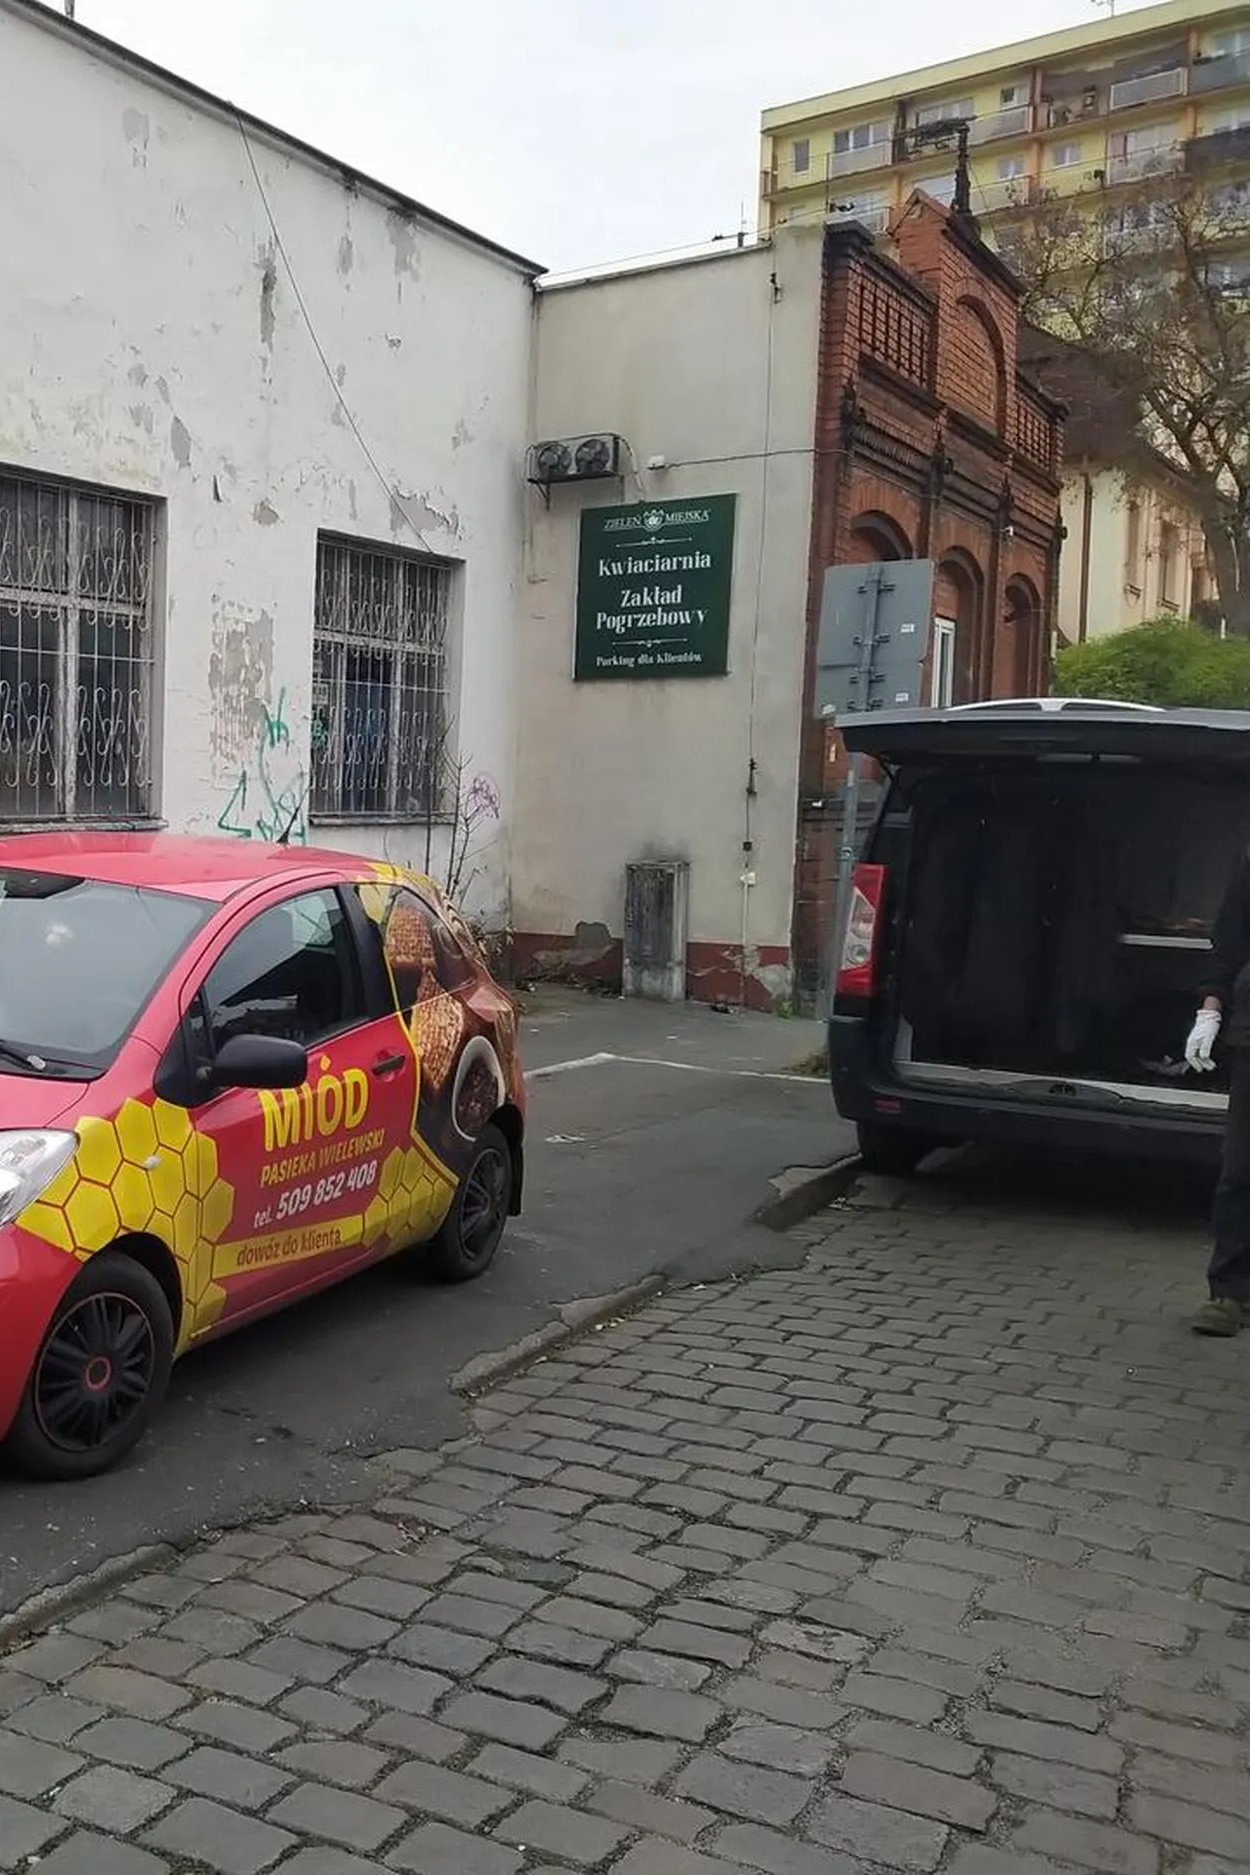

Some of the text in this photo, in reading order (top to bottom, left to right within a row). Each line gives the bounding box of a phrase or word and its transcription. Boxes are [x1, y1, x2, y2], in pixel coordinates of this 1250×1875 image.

[598, 551, 711, 576] Kwiaciarnia
[620, 584, 682, 608] Zakład
[596, 607, 709, 634] Pogrzebowy
[258, 1055, 369, 1152] MIÓD
[260, 1151, 316, 1189] PASIEKA
[254, 1160, 378, 1229] tel. 509 852 408
[236, 1227, 342, 1267] dowóz do klienta
